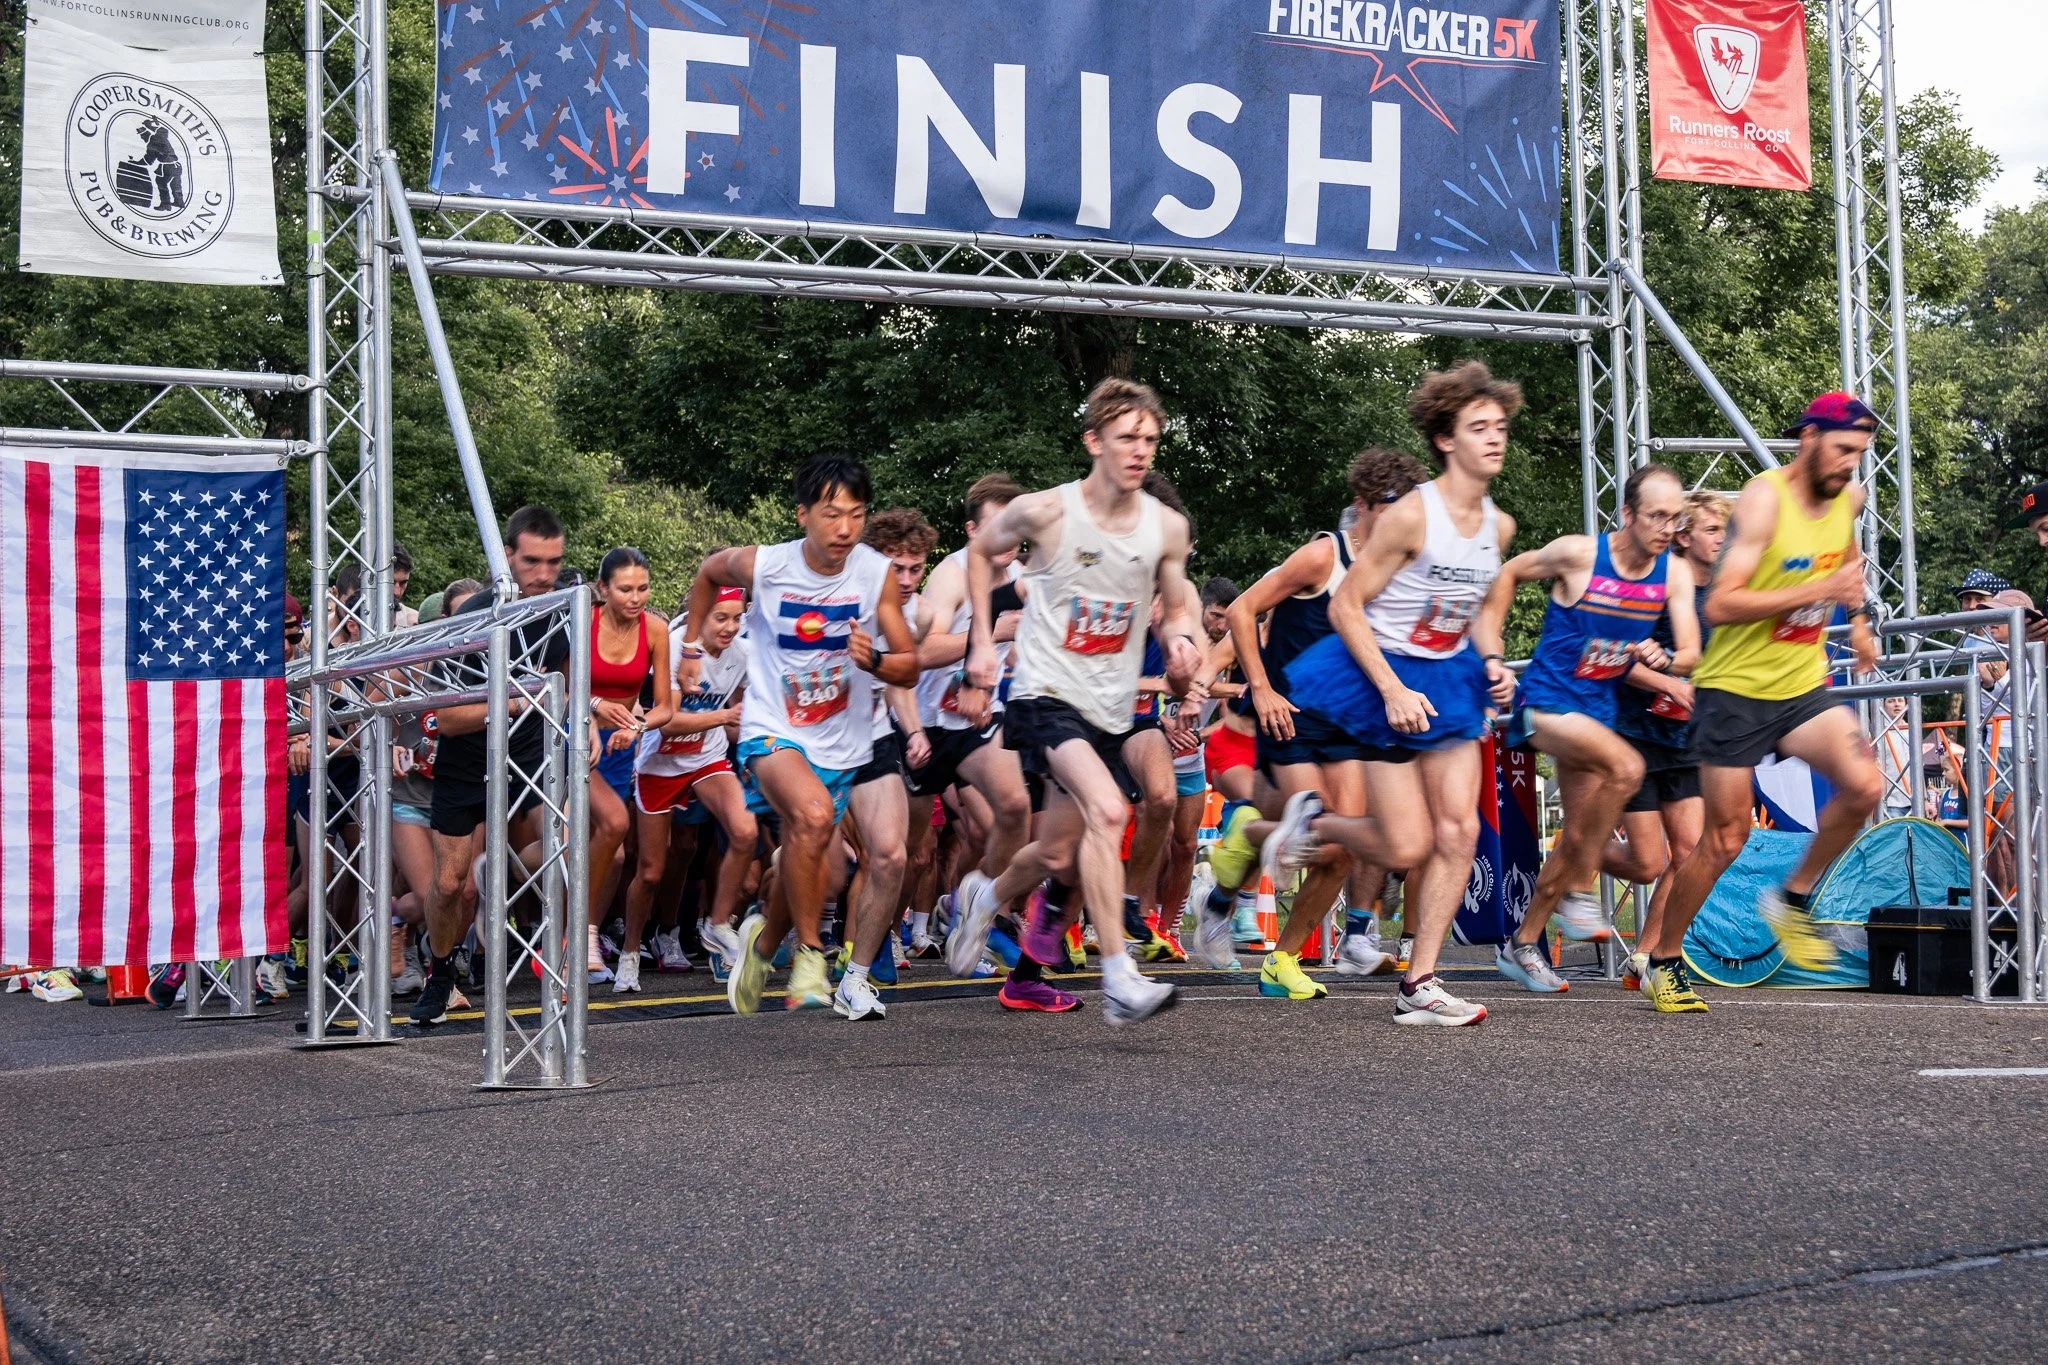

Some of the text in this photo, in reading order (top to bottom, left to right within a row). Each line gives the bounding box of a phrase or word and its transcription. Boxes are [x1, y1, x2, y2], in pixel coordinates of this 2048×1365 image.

[1268, 0, 1539, 60] FIREKRACKER 5K
[646, 27, 1400, 252] FINISH
[1669, 115, 1792, 144] Runners Roost
[1684, 136, 1710, 146] FORT
[1764, 143, 1780, 153] CO
[797, 683, 840, 707] 840
